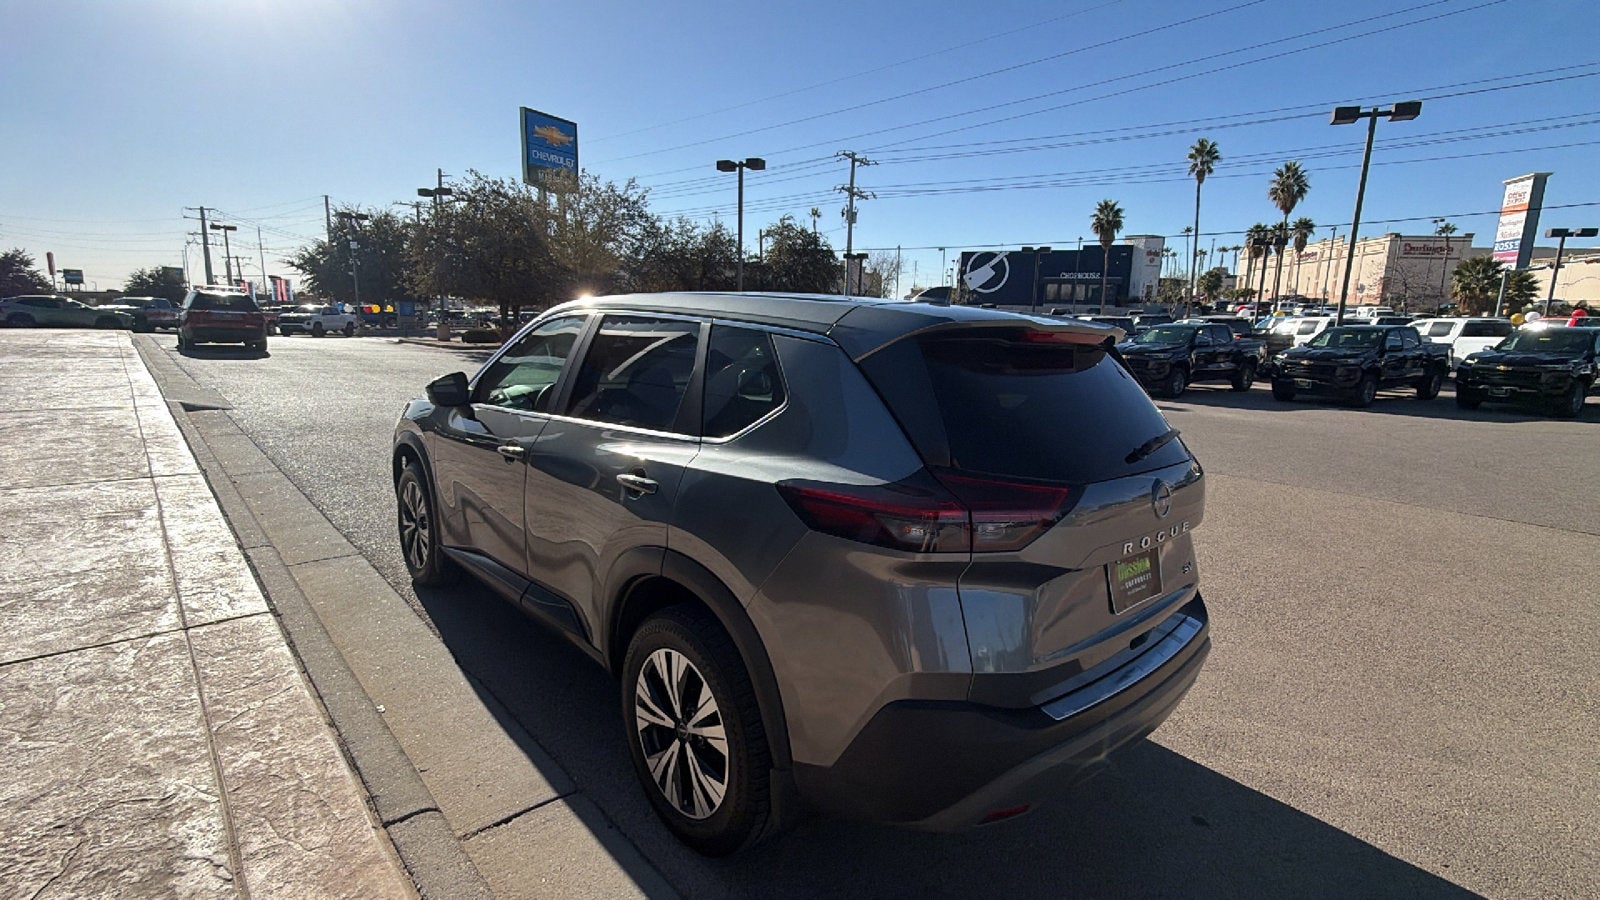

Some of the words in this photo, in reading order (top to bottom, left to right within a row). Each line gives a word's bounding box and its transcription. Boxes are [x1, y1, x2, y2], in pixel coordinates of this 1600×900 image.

[532, 150, 574, 168] CHEVROLET
[1494, 241, 1513, 251] ROSS
[1123, 522, 1189, 555] ROGUE
